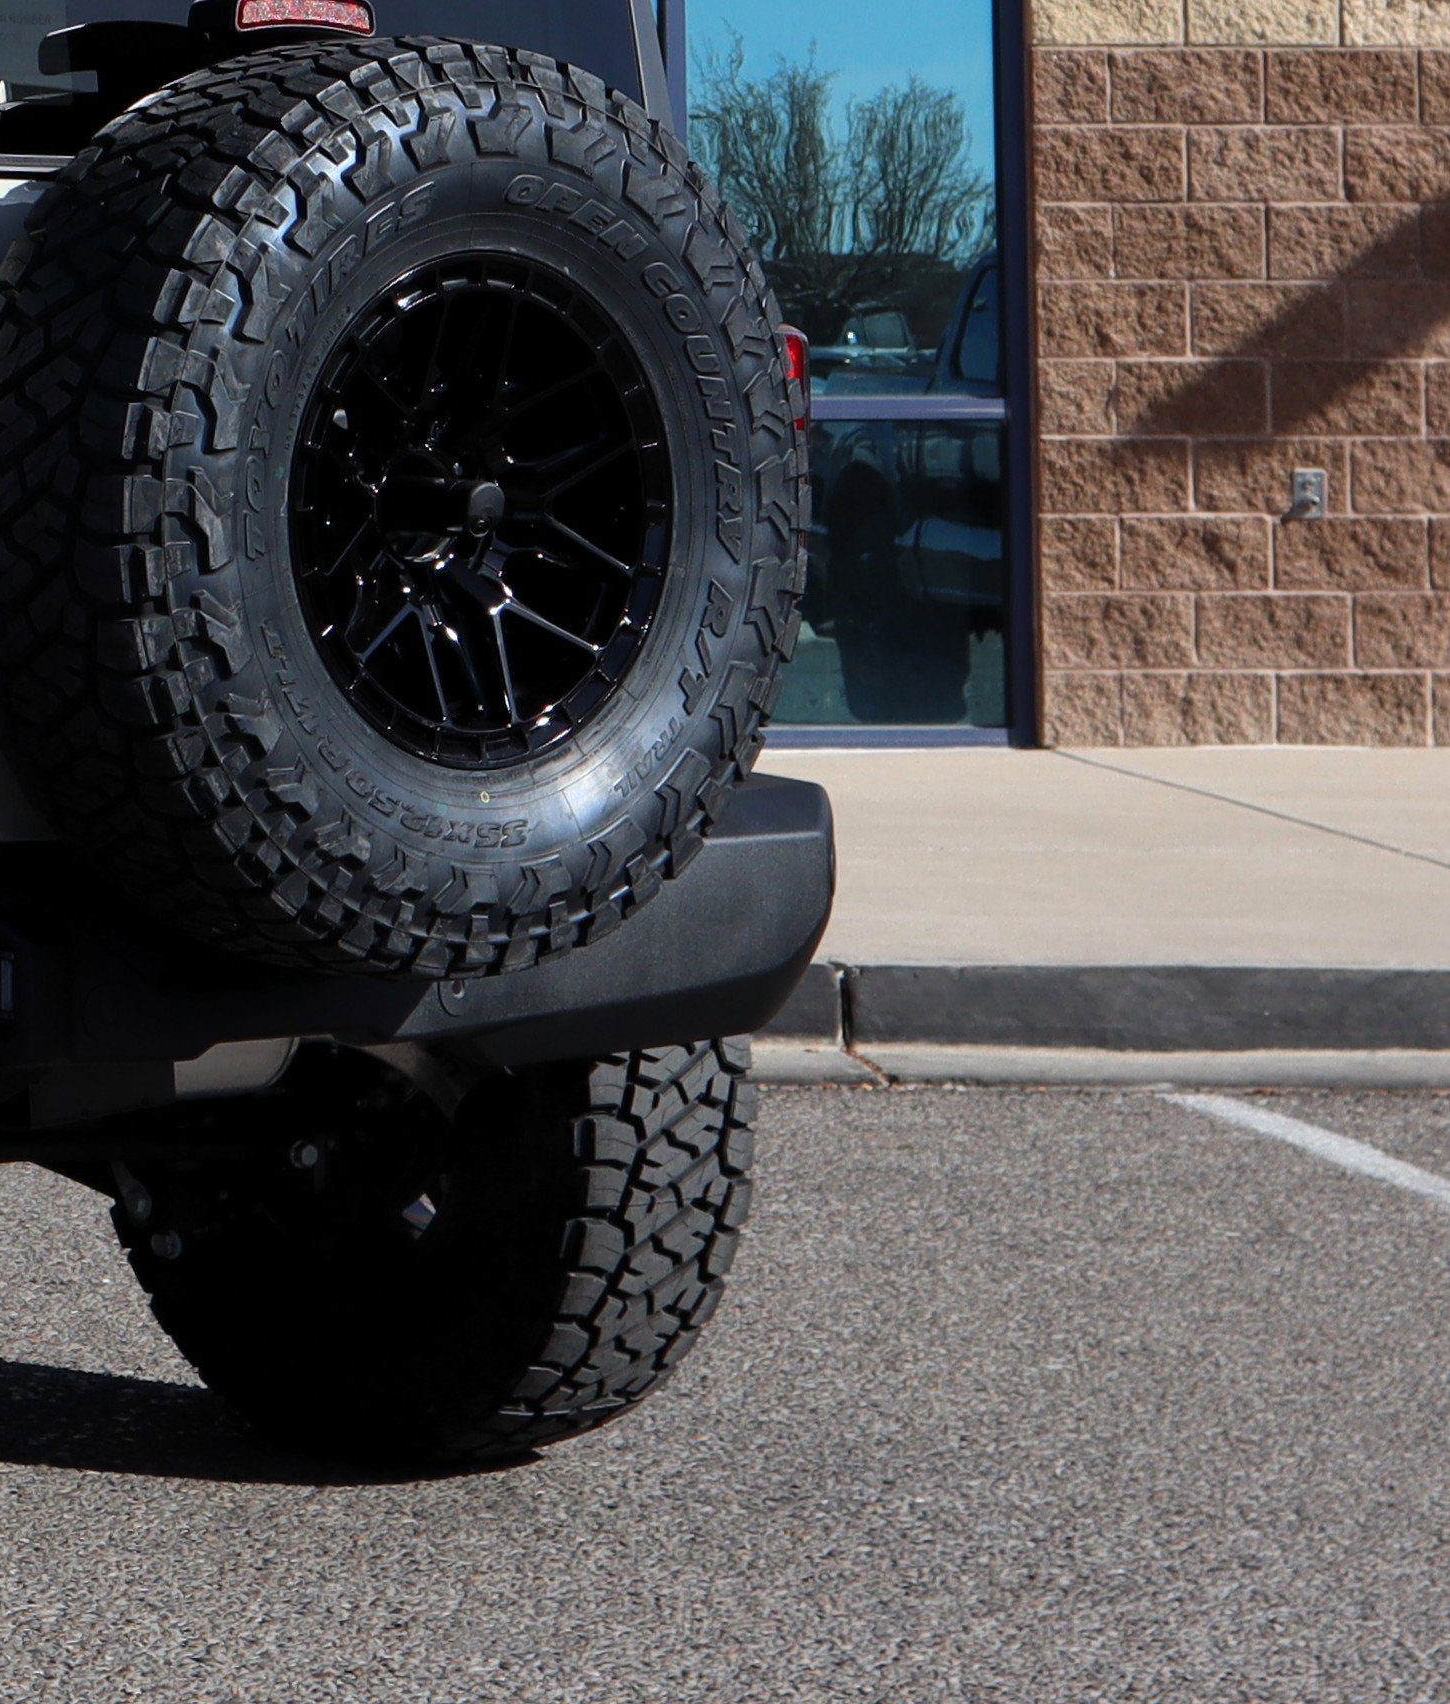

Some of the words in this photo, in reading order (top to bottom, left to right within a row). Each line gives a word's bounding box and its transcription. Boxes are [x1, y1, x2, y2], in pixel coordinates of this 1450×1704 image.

[505, 173, 650, 261] OPEN
[243, 349, 288, 562] TOYO
[285, 180, 436, 345] TIRES
[642, 260, 745, 565] COUNTRY
[678, 576, 735, 716] R/T
[613, 716, 685, 798] TRAIL
